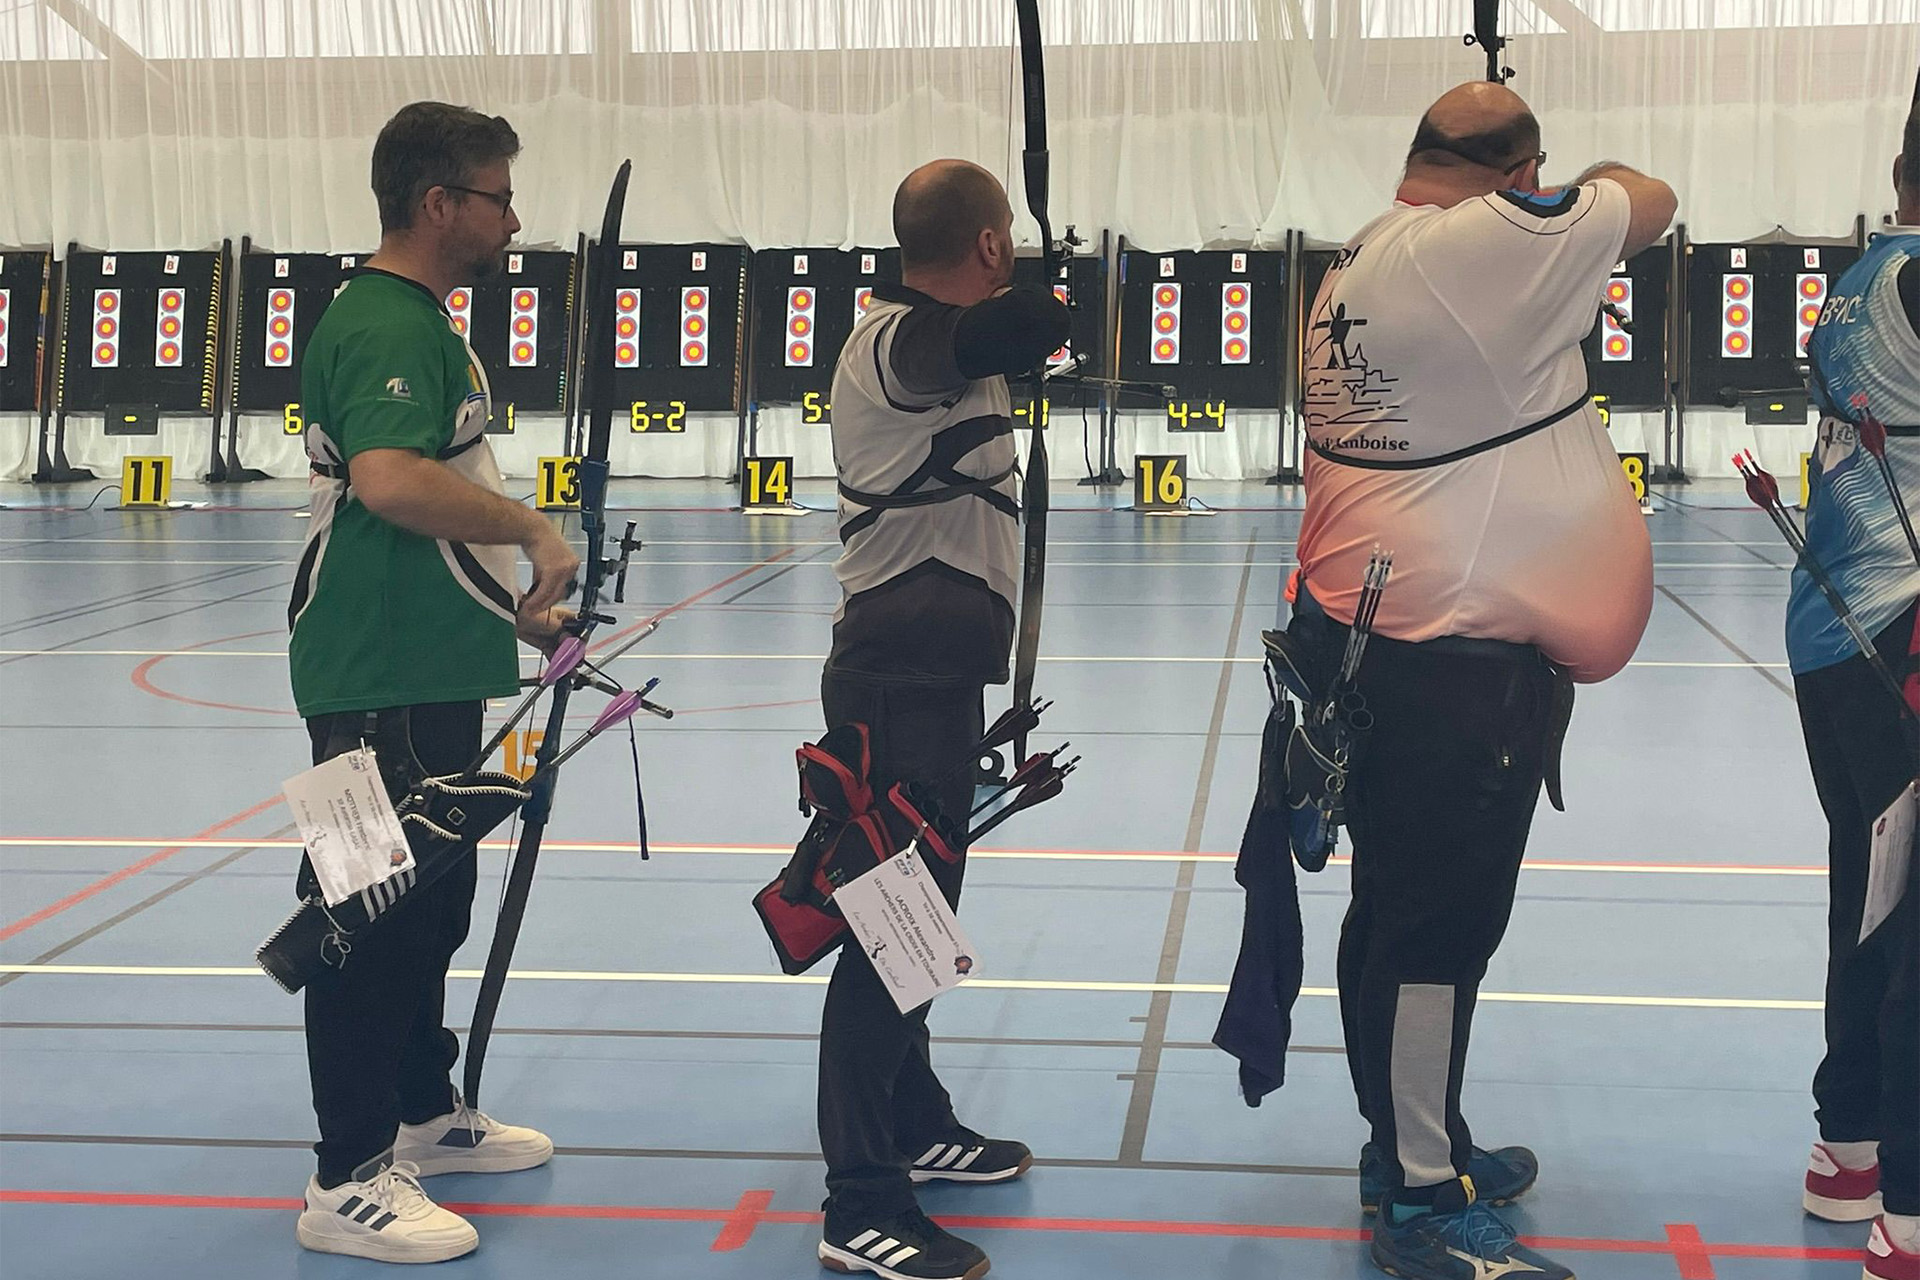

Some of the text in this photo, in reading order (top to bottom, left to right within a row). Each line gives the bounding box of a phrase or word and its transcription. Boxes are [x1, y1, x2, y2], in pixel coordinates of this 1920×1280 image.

[166, 260, 174, 270] B
[511, 260, 518, 270] B
[626, 256, 635, 266] A
[694, 257, 702, 267] B
[1233, 258, 1242, 269] B
[1734, 254, 1743, 265] A
[1807, 254, 1815, 265] B
[105, 262, 113, 272] A
[278, 264, 286, 274] A
[797, 261, 805, 271] A
[864, 260, 871, 271] B
[1163, 263, 1172, 273] A
[631, 401, 685, 431] 6-2
[1168, 402, 1225, 428] 4-4
[130, 461, 164, 503] 11
[542, 461, 581, 503] 13
[746, 461, 788, 504] 14
[1139, 460, 1184, 504] 16
[873, 877, 884, 889] LES
[899, 922, 909, 932] LA
[894, 893, 916, 926] LACROIX
